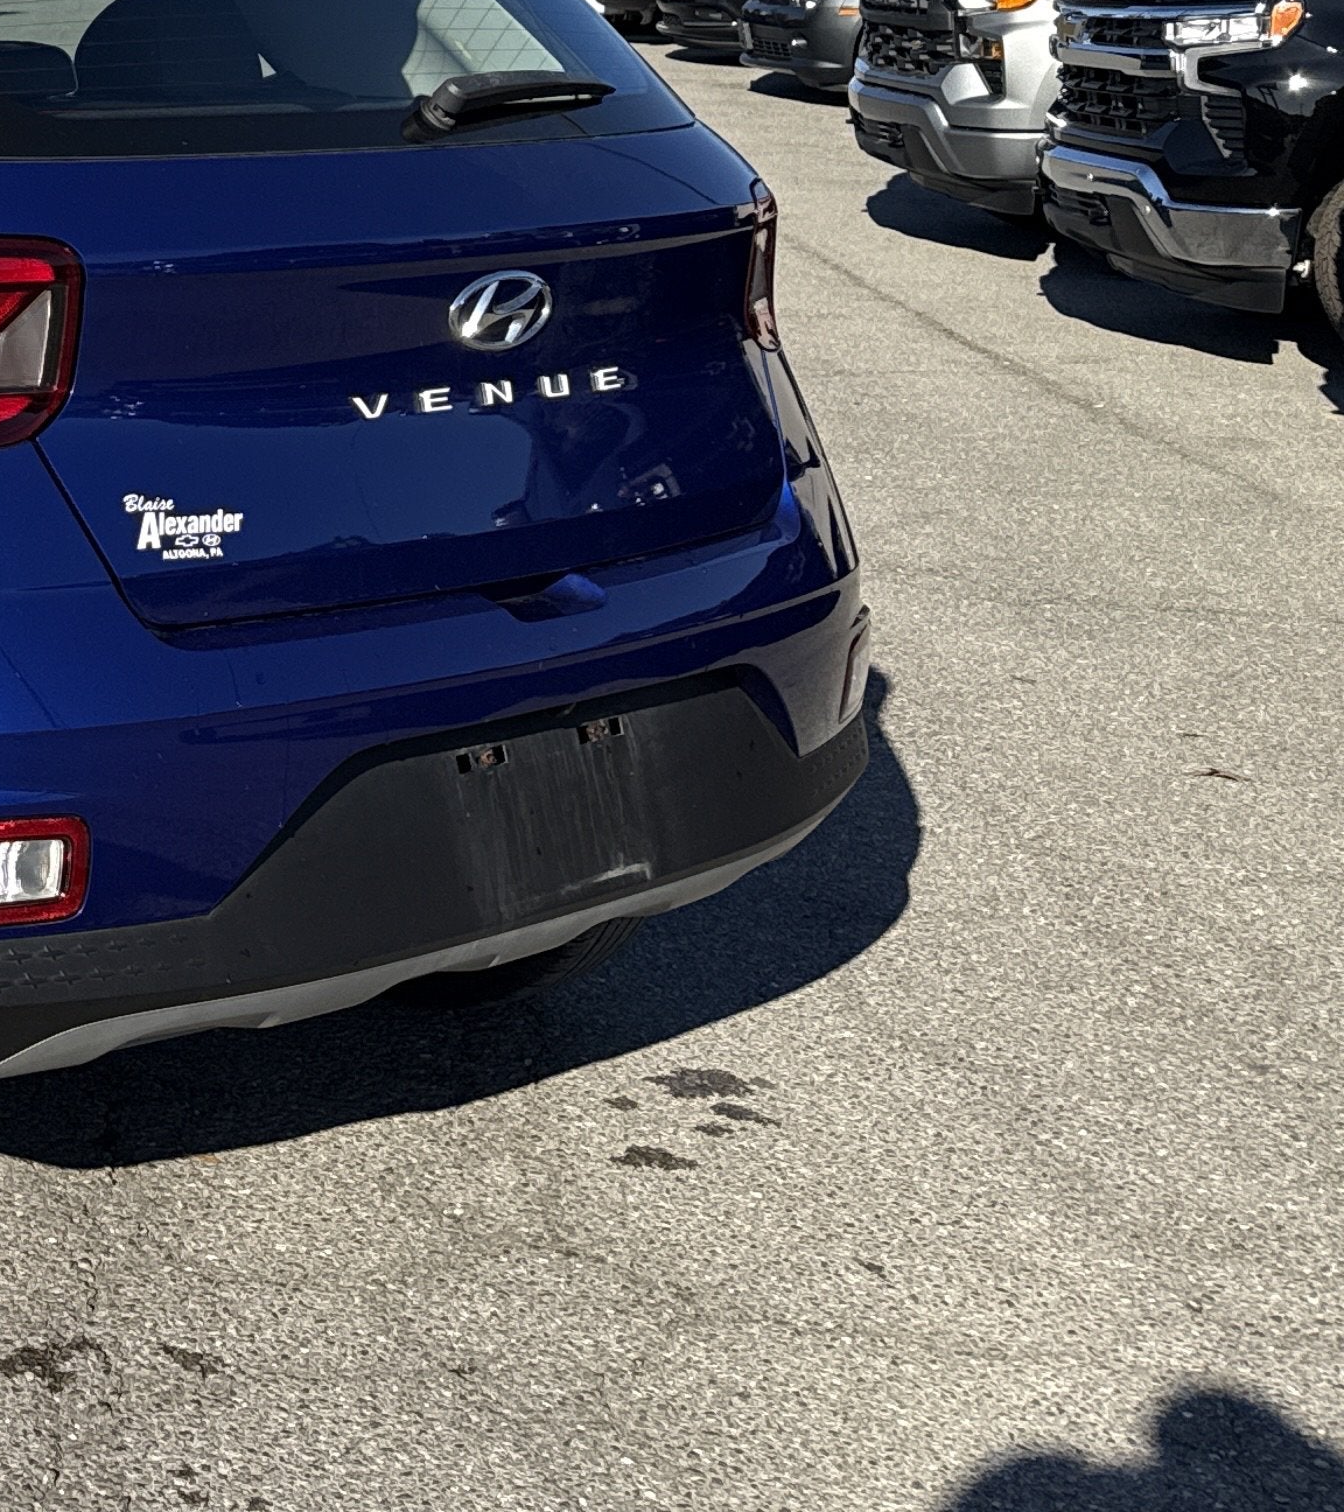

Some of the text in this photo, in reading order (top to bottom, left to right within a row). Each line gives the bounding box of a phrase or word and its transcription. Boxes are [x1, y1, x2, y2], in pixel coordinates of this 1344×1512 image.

[351, 366, 624, 420] VENUE
[123, 493, 174, 512] Blaise
[136, 508, 244, 550] Alexander
